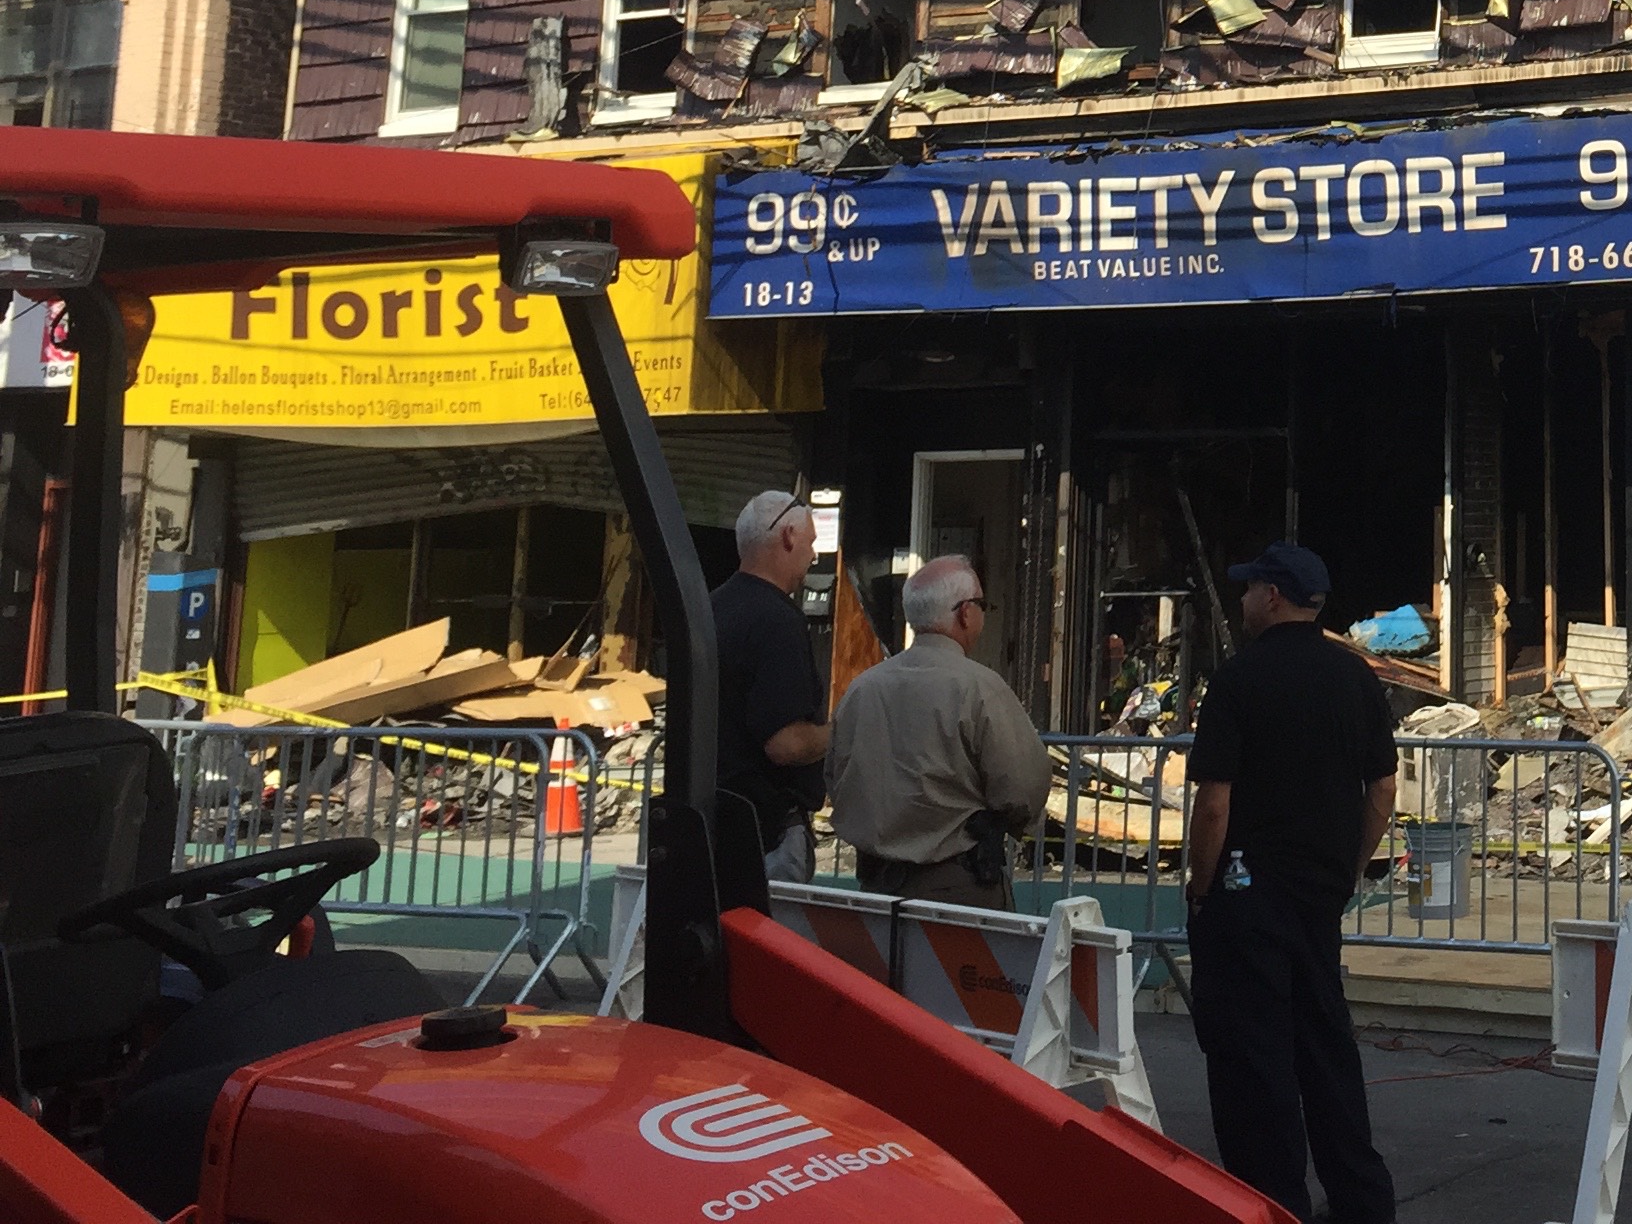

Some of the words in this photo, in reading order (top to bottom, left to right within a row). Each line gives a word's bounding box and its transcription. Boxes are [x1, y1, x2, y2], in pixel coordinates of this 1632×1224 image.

[931, 170, 1236, 259] VARIETY
[1250, 151, 1508, 244] STORE
[828, 243, 845, 263] &
[848, 239, 881, 262] UP
[1033, 258, 1091, 281] BEAT
[1096, 255, 1172, 279] VALUE
[1177, 253, 1225, 276] INC.
[230, 267, 530, 340] Florist
[742, 281, 815, 307] 18-13
[144, 365, 199, 388] Designs
[211, 364, 256, 385] Ballon
[260, 365, 328, 389] Bouquets
[340, 364, 383, 385] Floral
[386, 365, 477, 387] Arrangement
[489, 359, 524, 380] Fruit
[529, 356, 574, 378] Basket
[633, 350, 683, 372] Events
[187, 591, 205, 618] P
[979, 975, 1032, 996] conEdiso
[701, 1141, 914, 1222] conEdison
